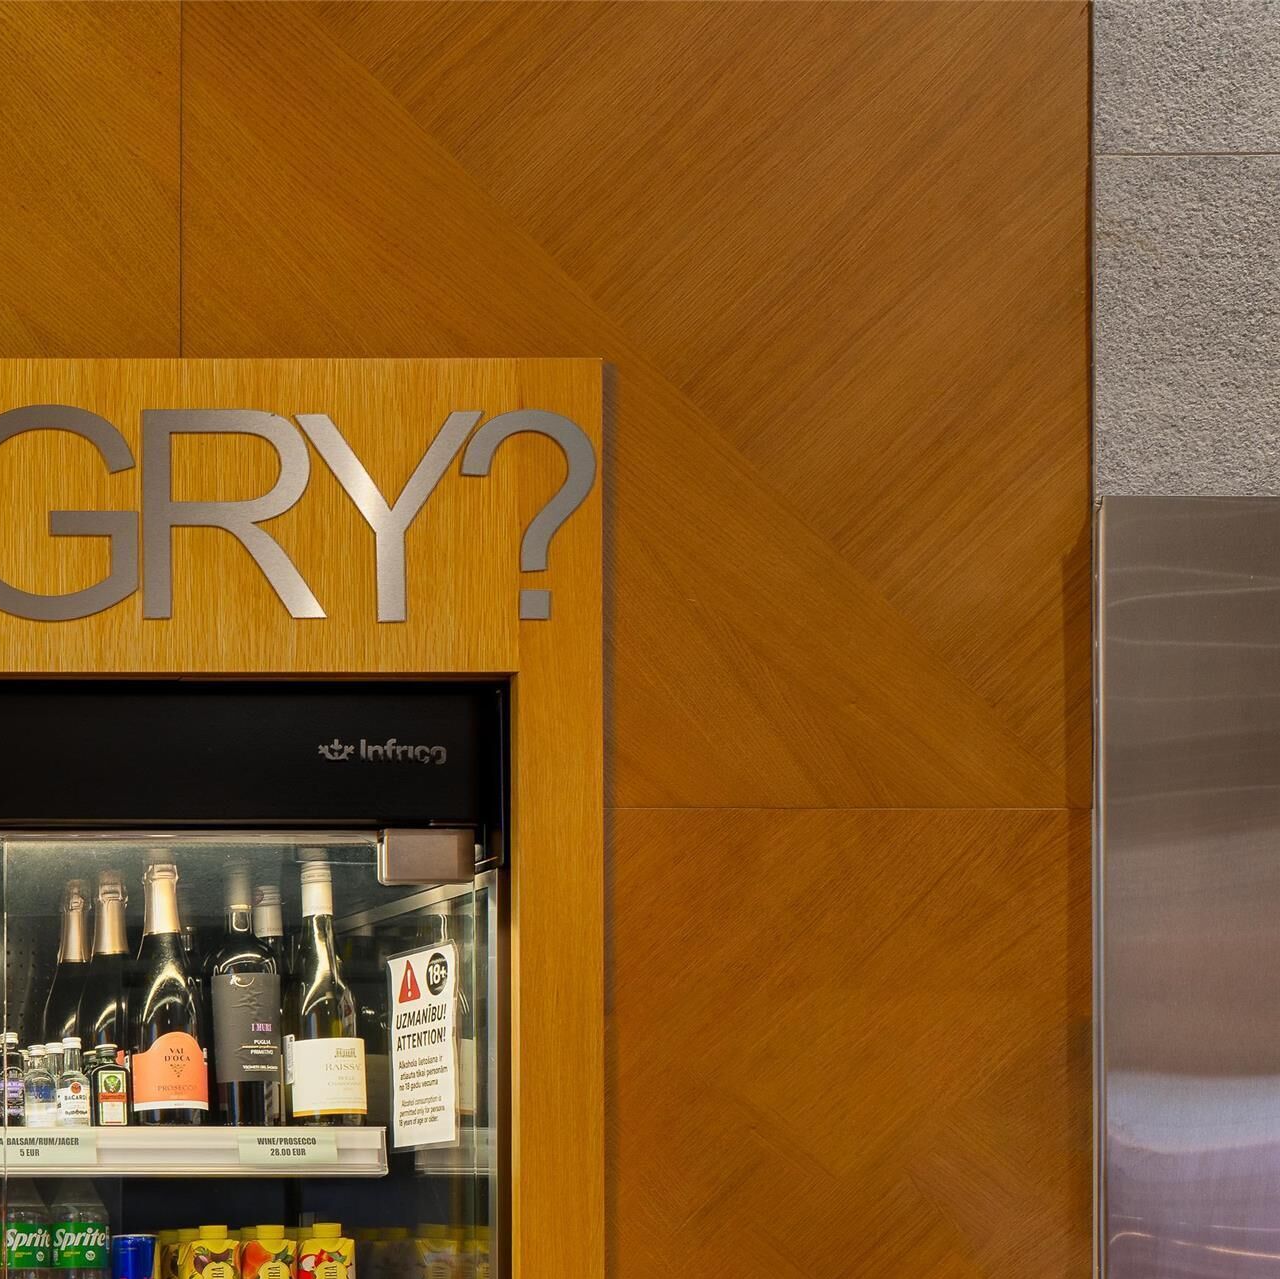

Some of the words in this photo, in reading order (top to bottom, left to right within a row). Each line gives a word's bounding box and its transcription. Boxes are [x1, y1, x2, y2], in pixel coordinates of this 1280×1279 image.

[428, 964, 447, 986] 18+
[396, 1004, 447, 1029] UZMANĪBU!
[397, 1027, 446, 1053] ATTENTION!
[6, 1137, 79, 1146] BALSAM/RUM/JAGER
[257, 1137, 317, 1145] WINE/PROSECCO
[20, 1149, 25, 1157] 5
[26, 1149, 40, 1157] EUR
[270, 1148, 292, 1156] 28.00
[293, 1148, 307, 1156] EUR
[53, 1227, 106, 1251] Sprite
